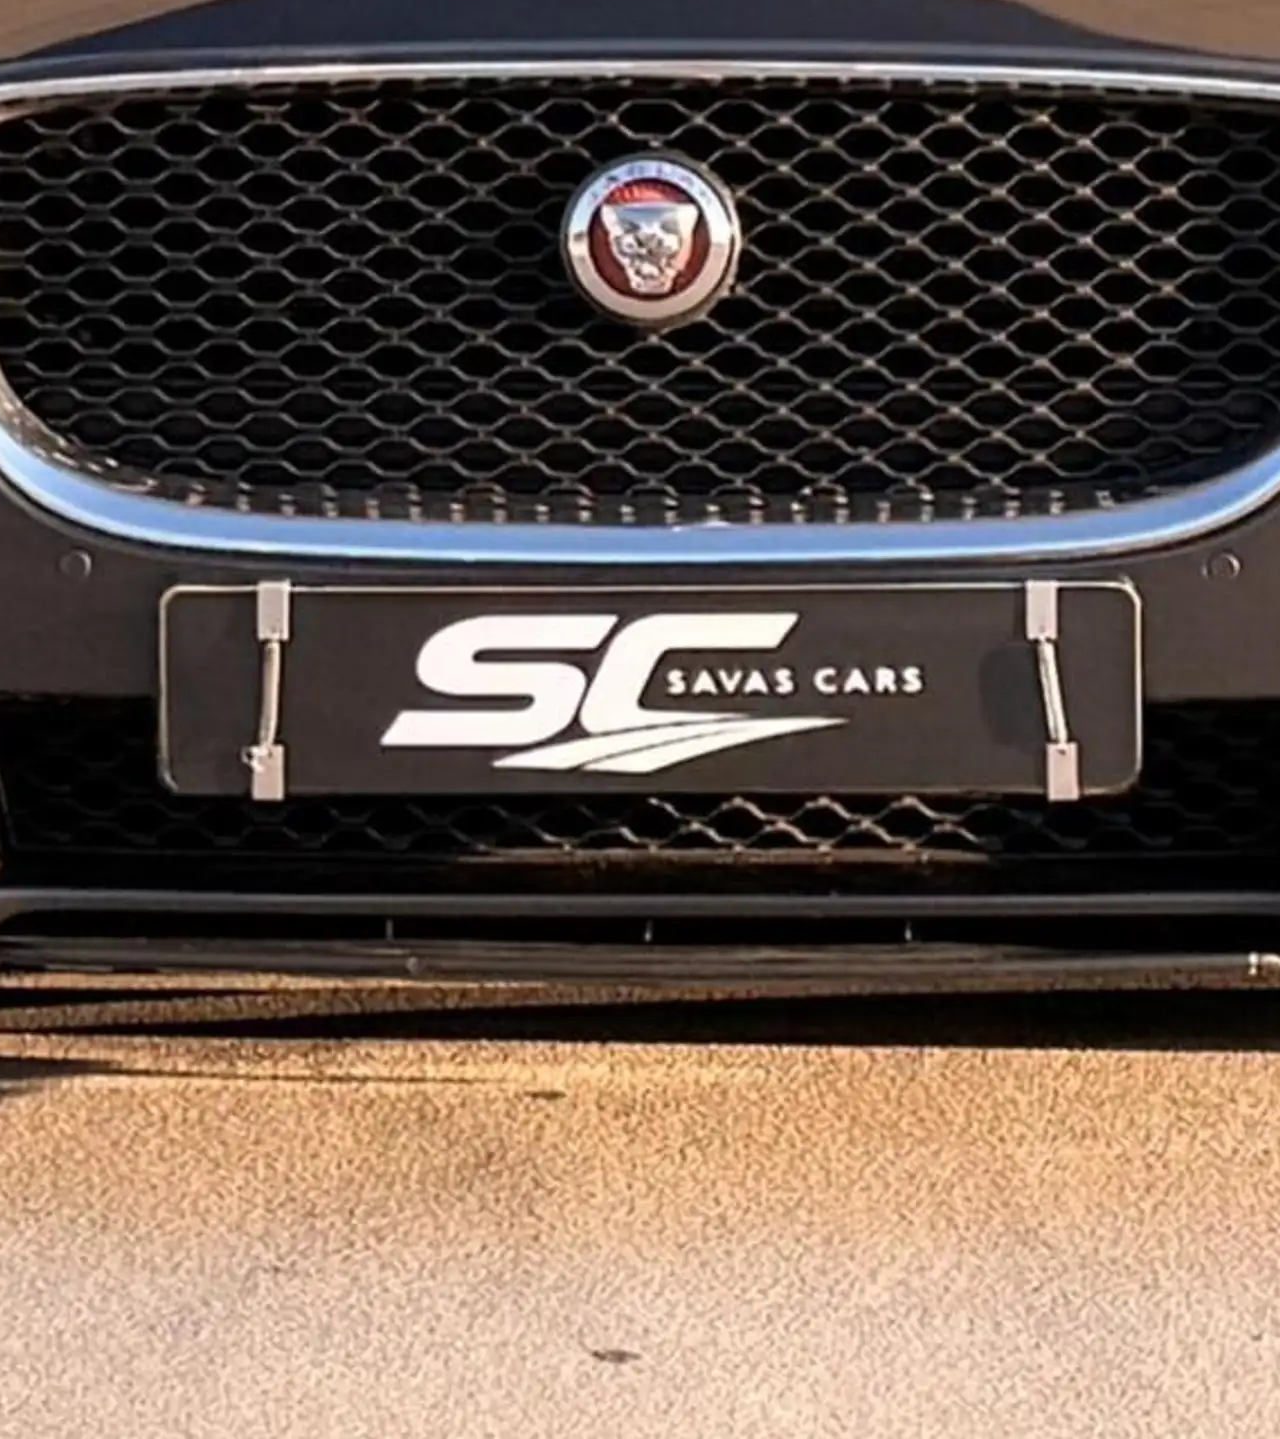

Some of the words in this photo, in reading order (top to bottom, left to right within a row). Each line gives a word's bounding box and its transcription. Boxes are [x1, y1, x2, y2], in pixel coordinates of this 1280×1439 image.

[381, 613, 801, 748] SC
[666, 666, 795, 696] SAVAS
[813, 665, 924, 695] CARS
